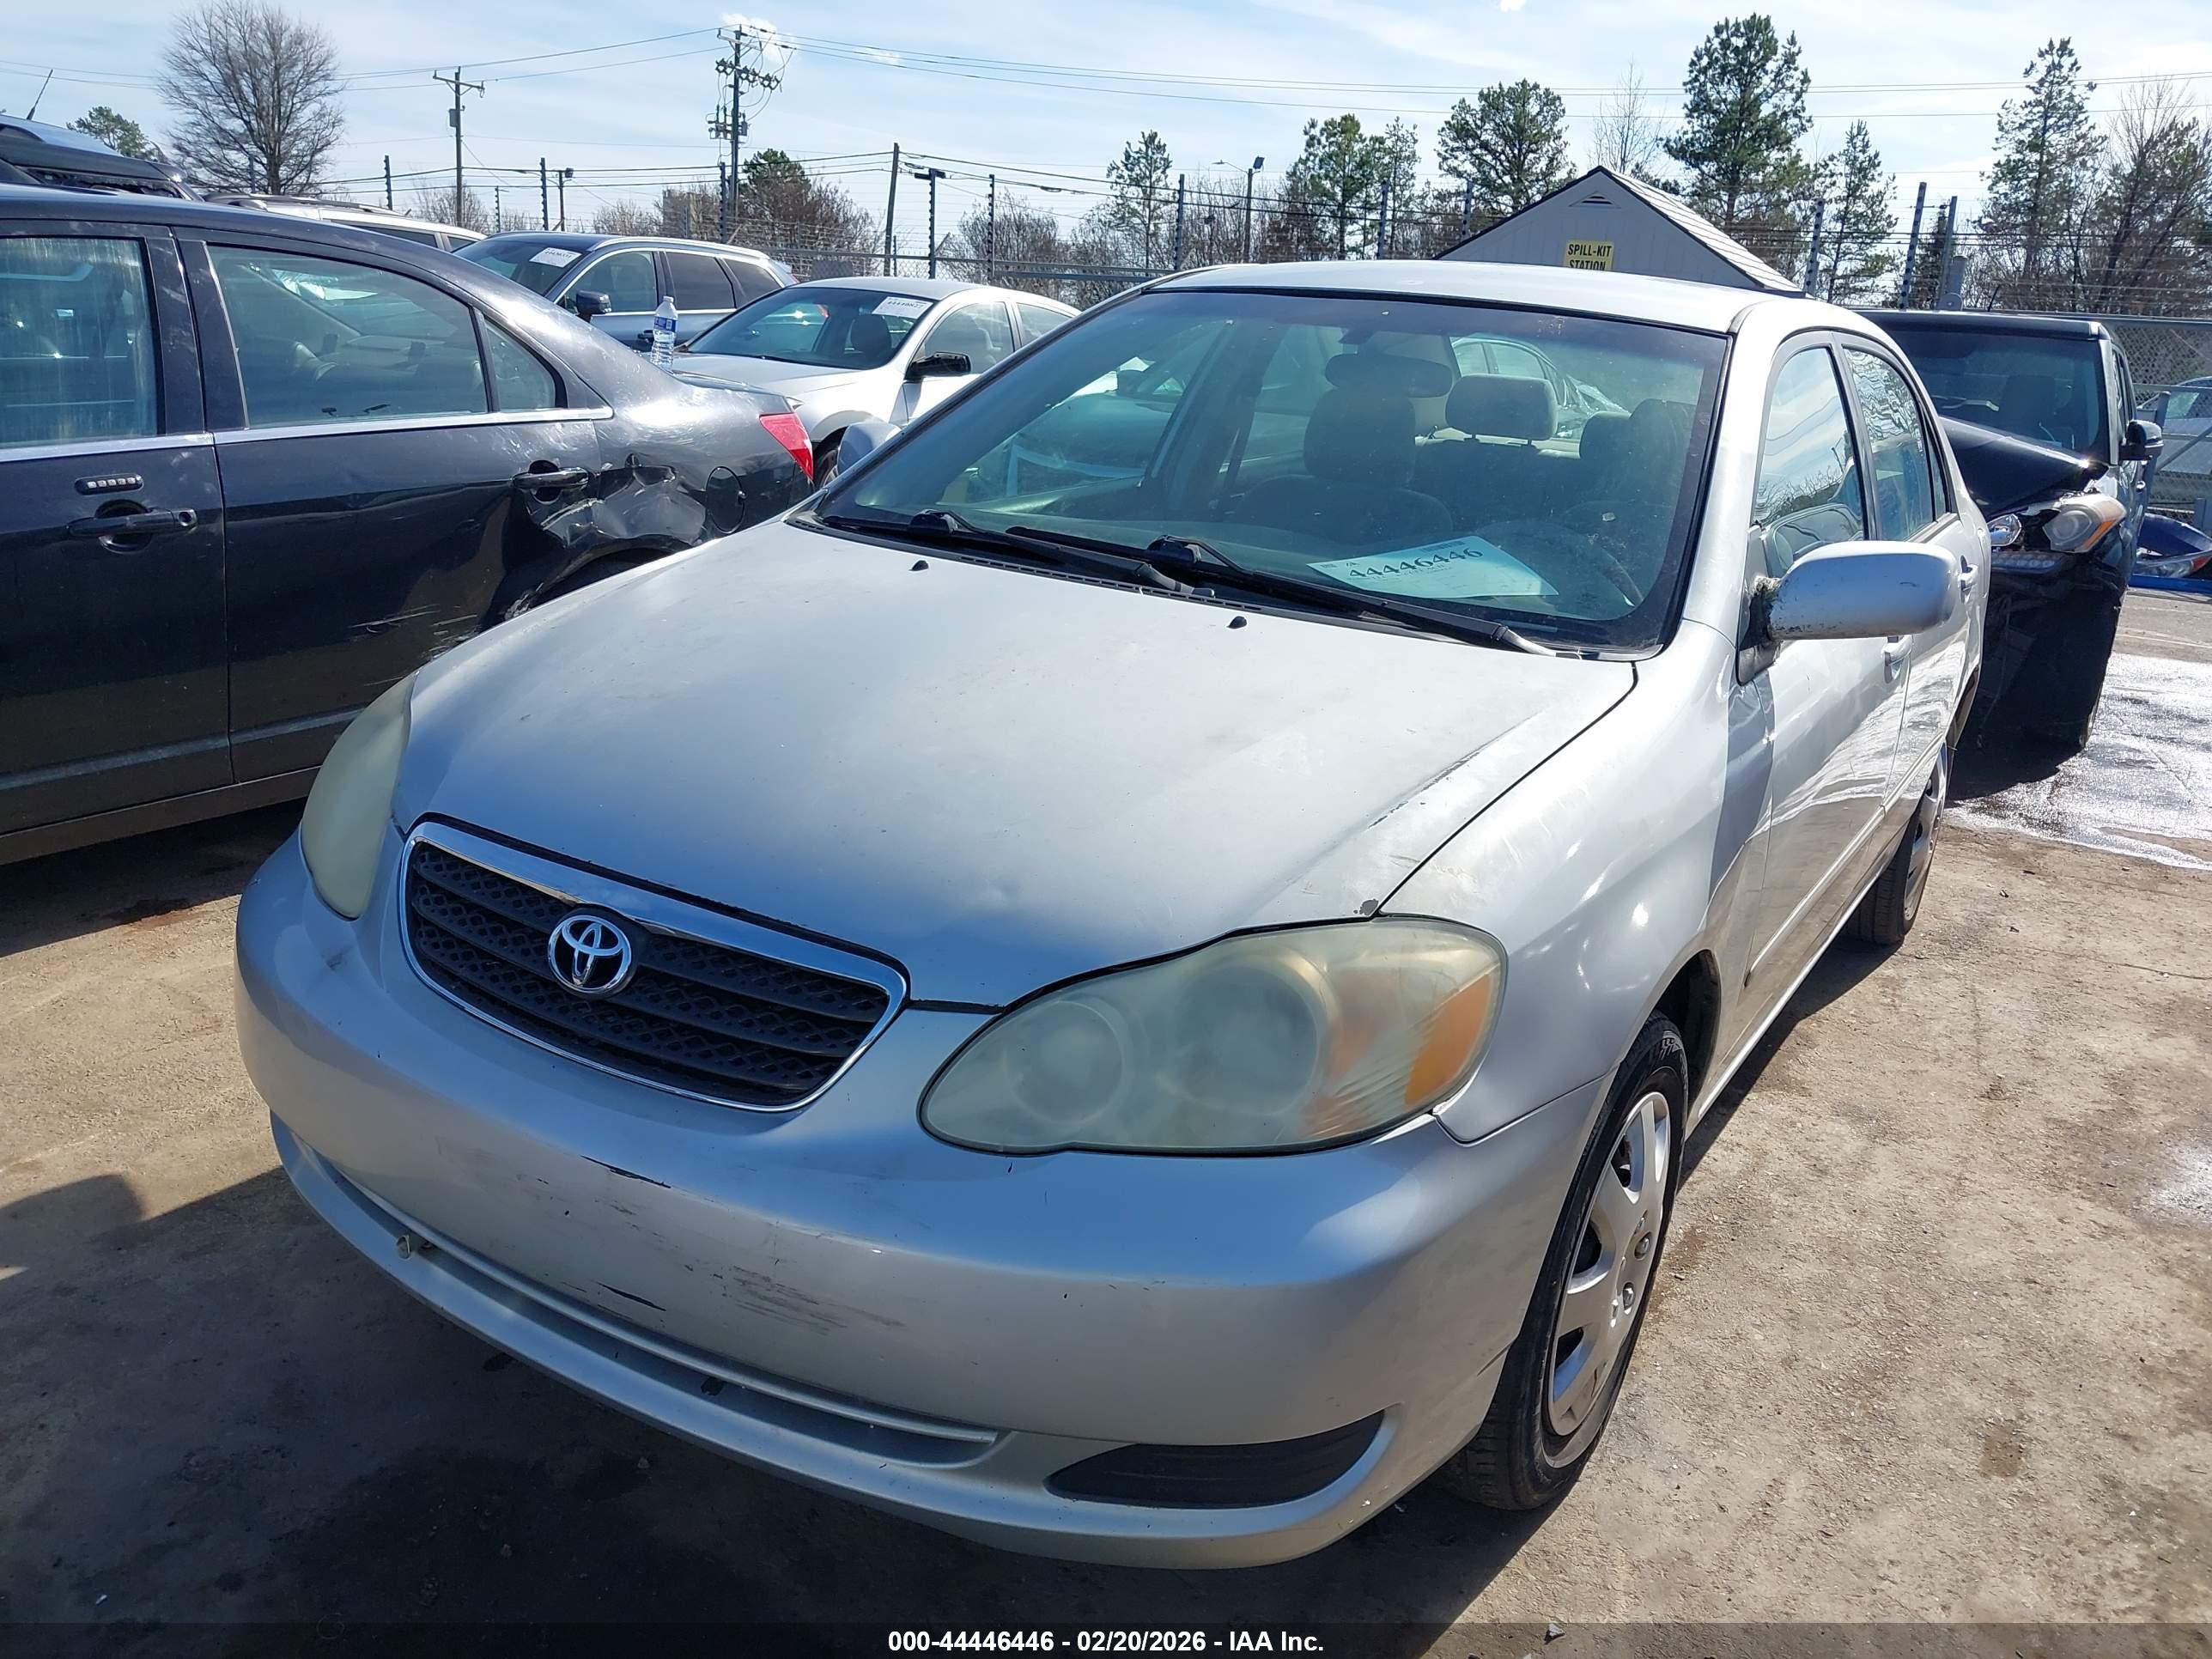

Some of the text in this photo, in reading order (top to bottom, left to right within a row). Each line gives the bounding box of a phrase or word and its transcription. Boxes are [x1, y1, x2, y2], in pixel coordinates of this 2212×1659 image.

[1568, 244, 1612, 257] SPILL-KIT
[1570, 259, 1606, 270] STATION
[1350, 548, 1483, 578] 44446446
